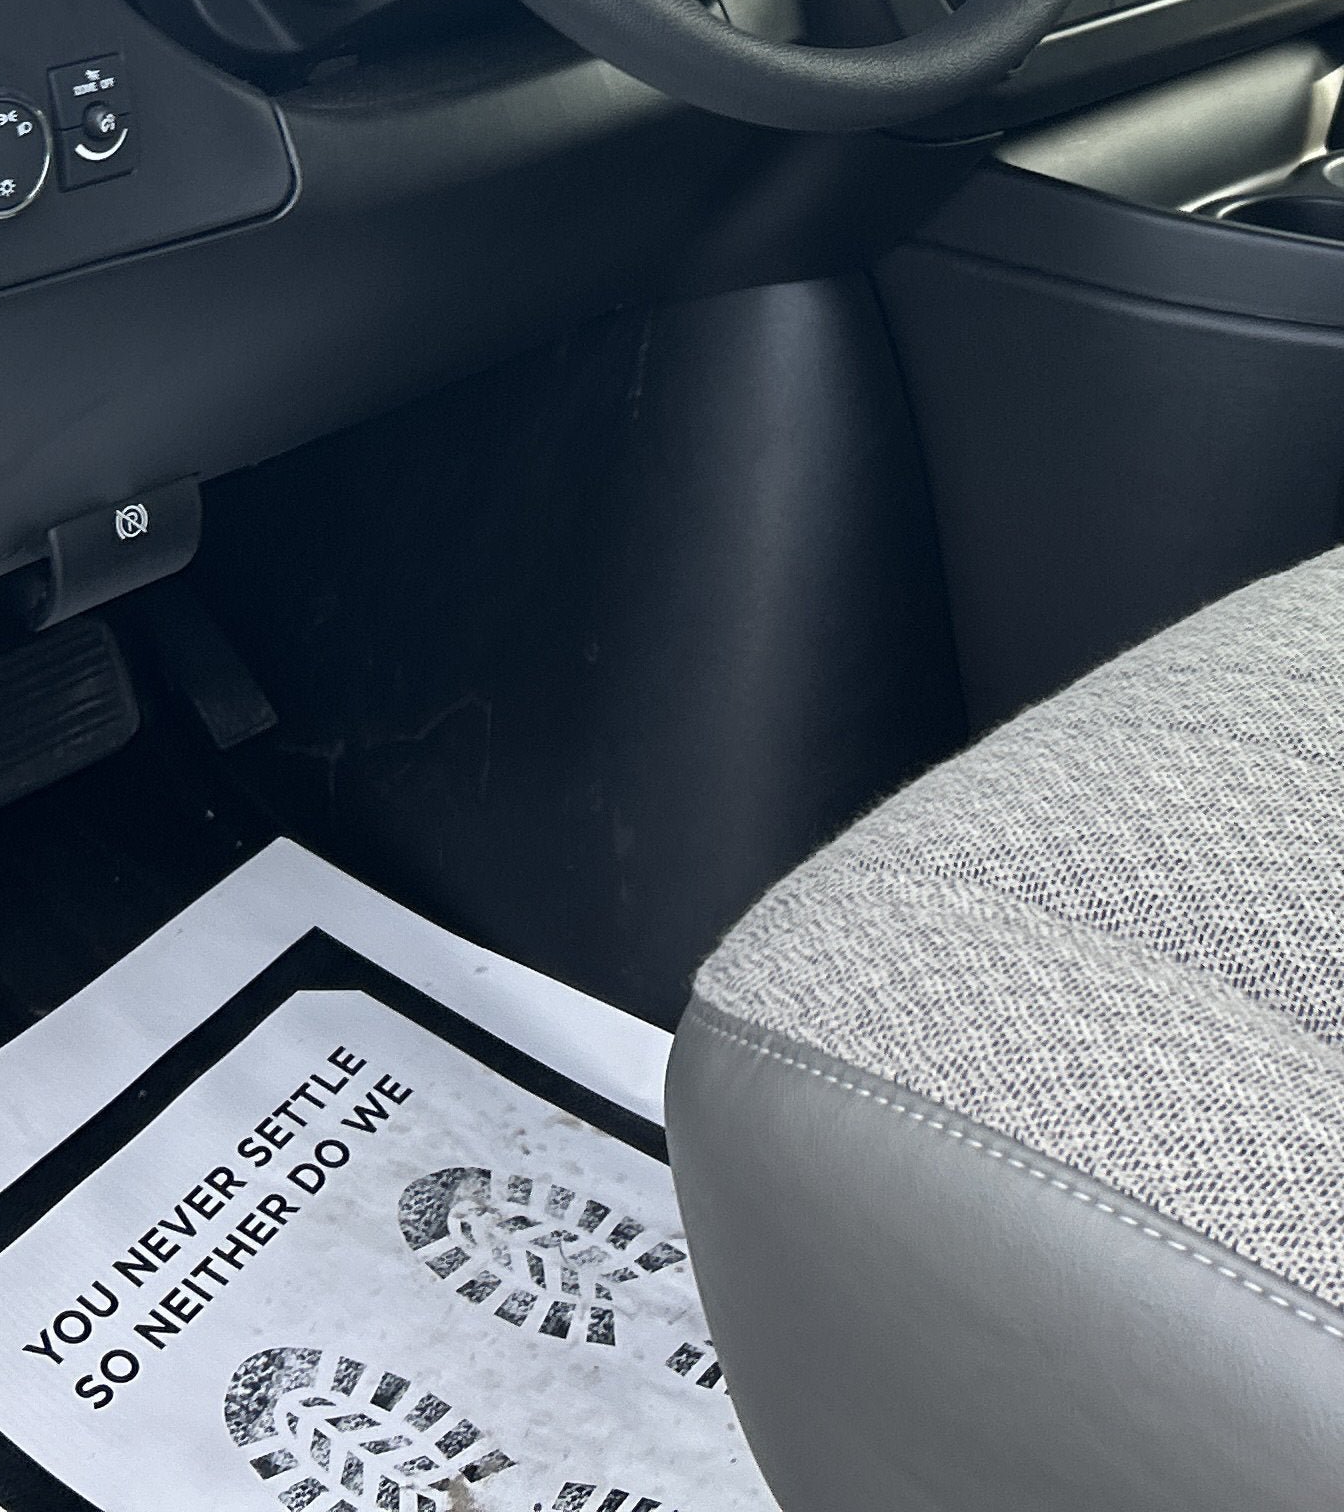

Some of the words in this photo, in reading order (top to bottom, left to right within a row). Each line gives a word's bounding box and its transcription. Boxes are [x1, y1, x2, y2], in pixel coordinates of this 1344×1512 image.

[22, 1280, 120, 1365] YOU
[112, 1165, 248, 1288] NEVER
[237, 1045, 367, 1168] SETTLE
[75, 1349, 140, 1410] SO
[133, 1192, 301, 1350] NEITHER
[287, 1139, 351, 1195] DO
[340, 1073, 415, 1133] WE
